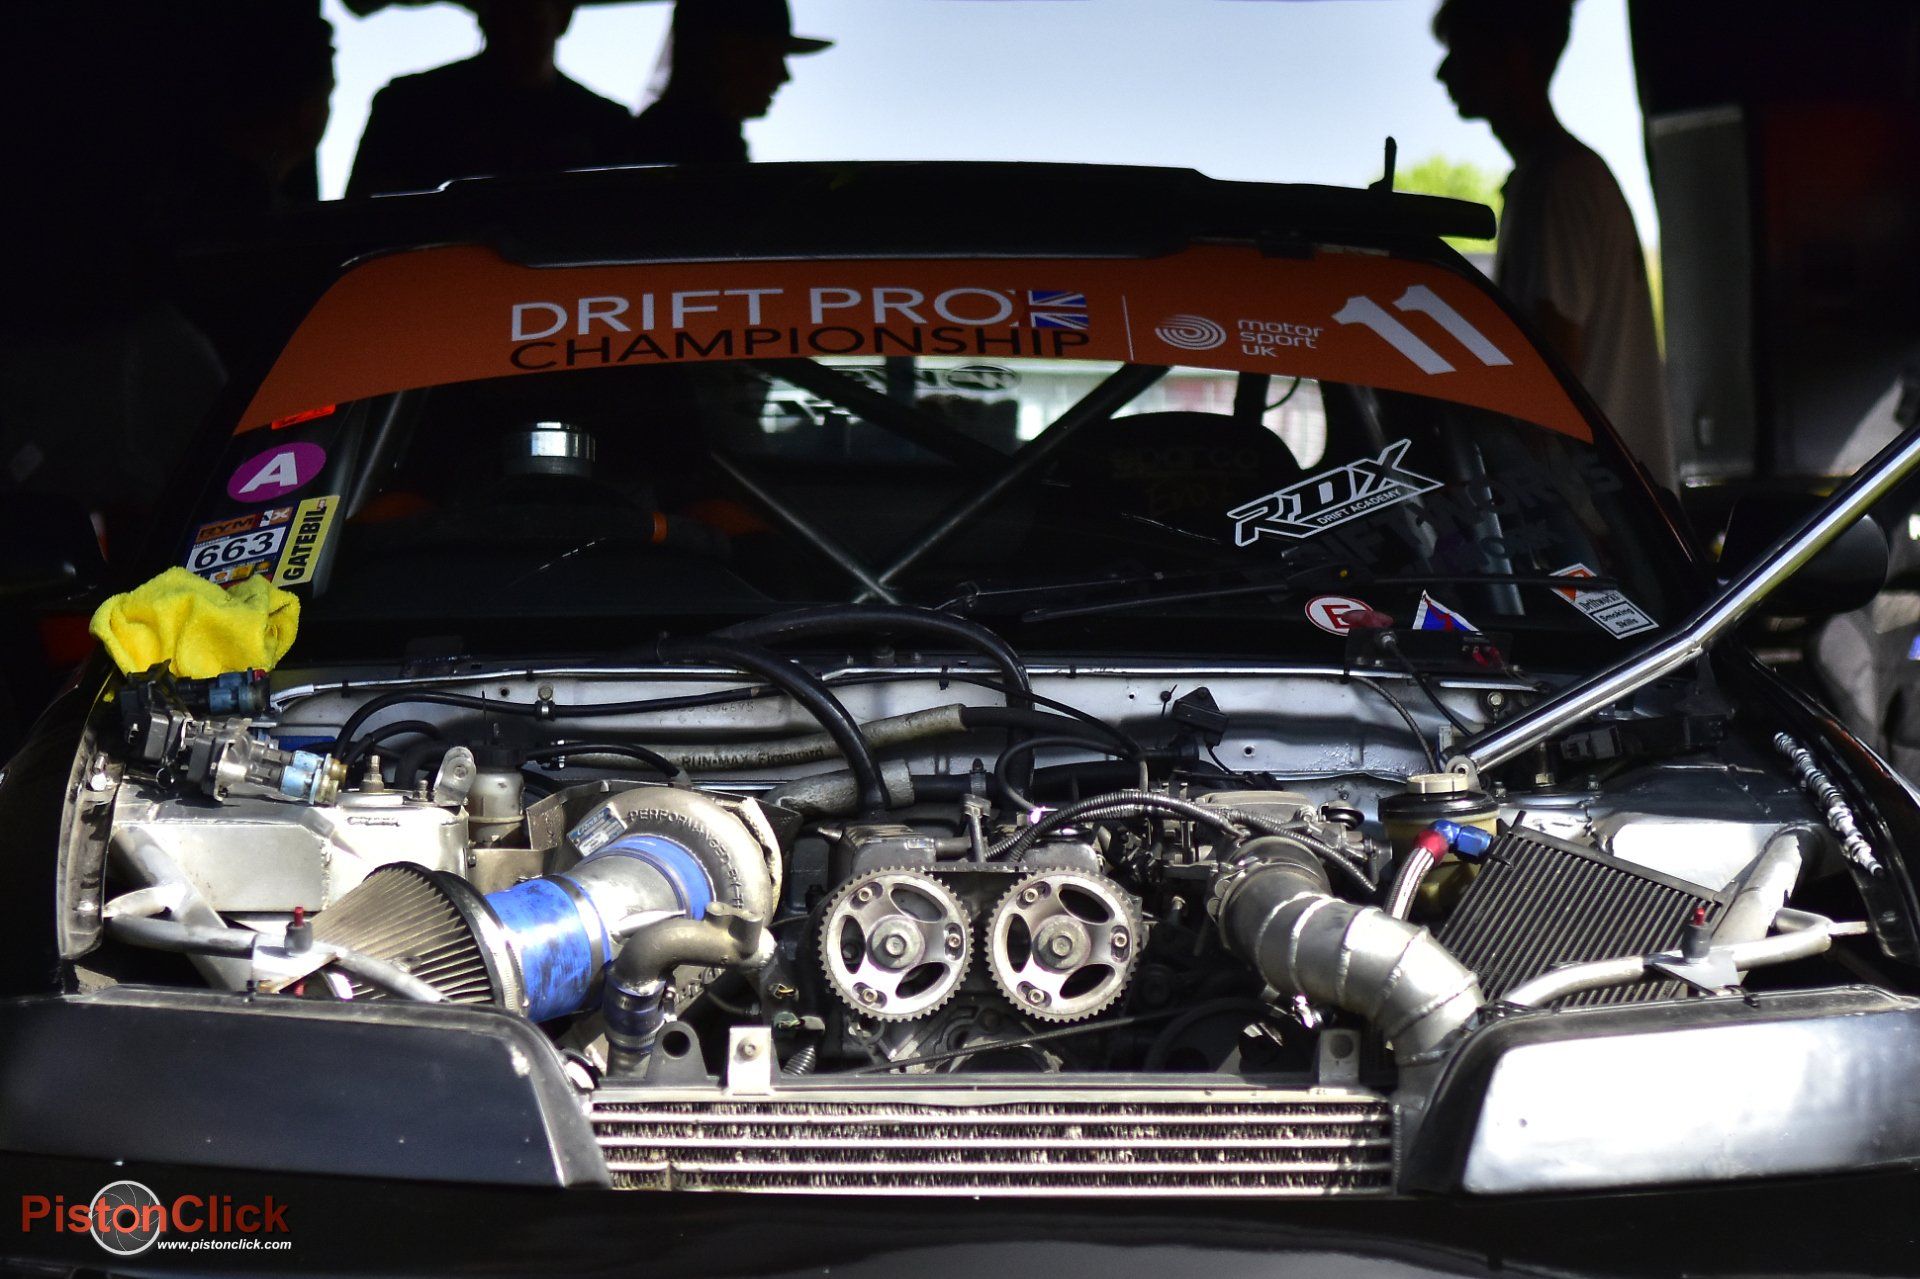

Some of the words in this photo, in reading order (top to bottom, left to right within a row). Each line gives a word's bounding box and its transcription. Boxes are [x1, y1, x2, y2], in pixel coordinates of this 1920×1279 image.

[511, 288, 784, 342] DRIFT
[810, 287, 1014, 327] PRO
[1238, 319, 1323, 337] motor
[1331, 284, 1514, 375] 11
[510, 325, 1090, 371] CHAMPIONSHIP
[1240, 331, 1317, 349] sport
[1242, 344, 1279, 357] UK
[238, 451, 298, 494] A
[1316, 507, 1351, 527] DRIFT
[1349, 488, 1402, 515] ACADEMY
[194, 532, 275, 570] 663
[282, 504, 328, 581] GATEBIL
